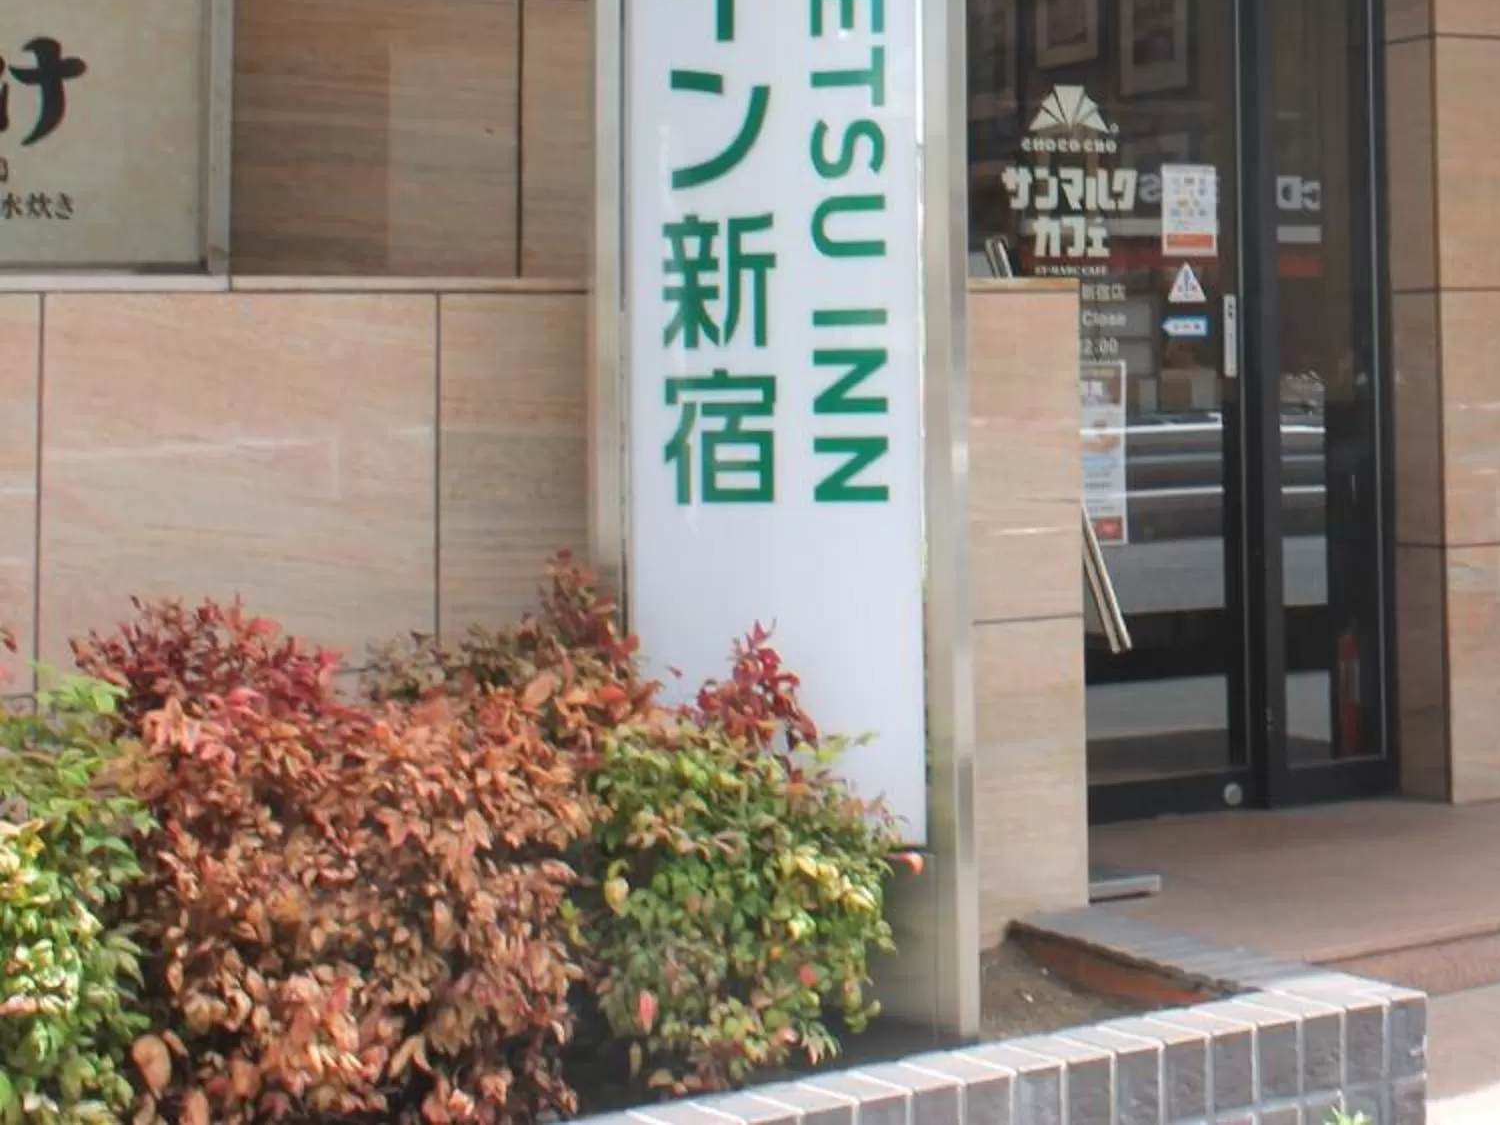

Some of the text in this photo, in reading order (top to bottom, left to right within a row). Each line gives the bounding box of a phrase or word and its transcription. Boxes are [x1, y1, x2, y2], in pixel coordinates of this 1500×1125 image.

[1001, 165, 1138, 211] サンマルク
[1032, 215, 1110, 258] カフェ
[812, 308, 890, 506] INN
